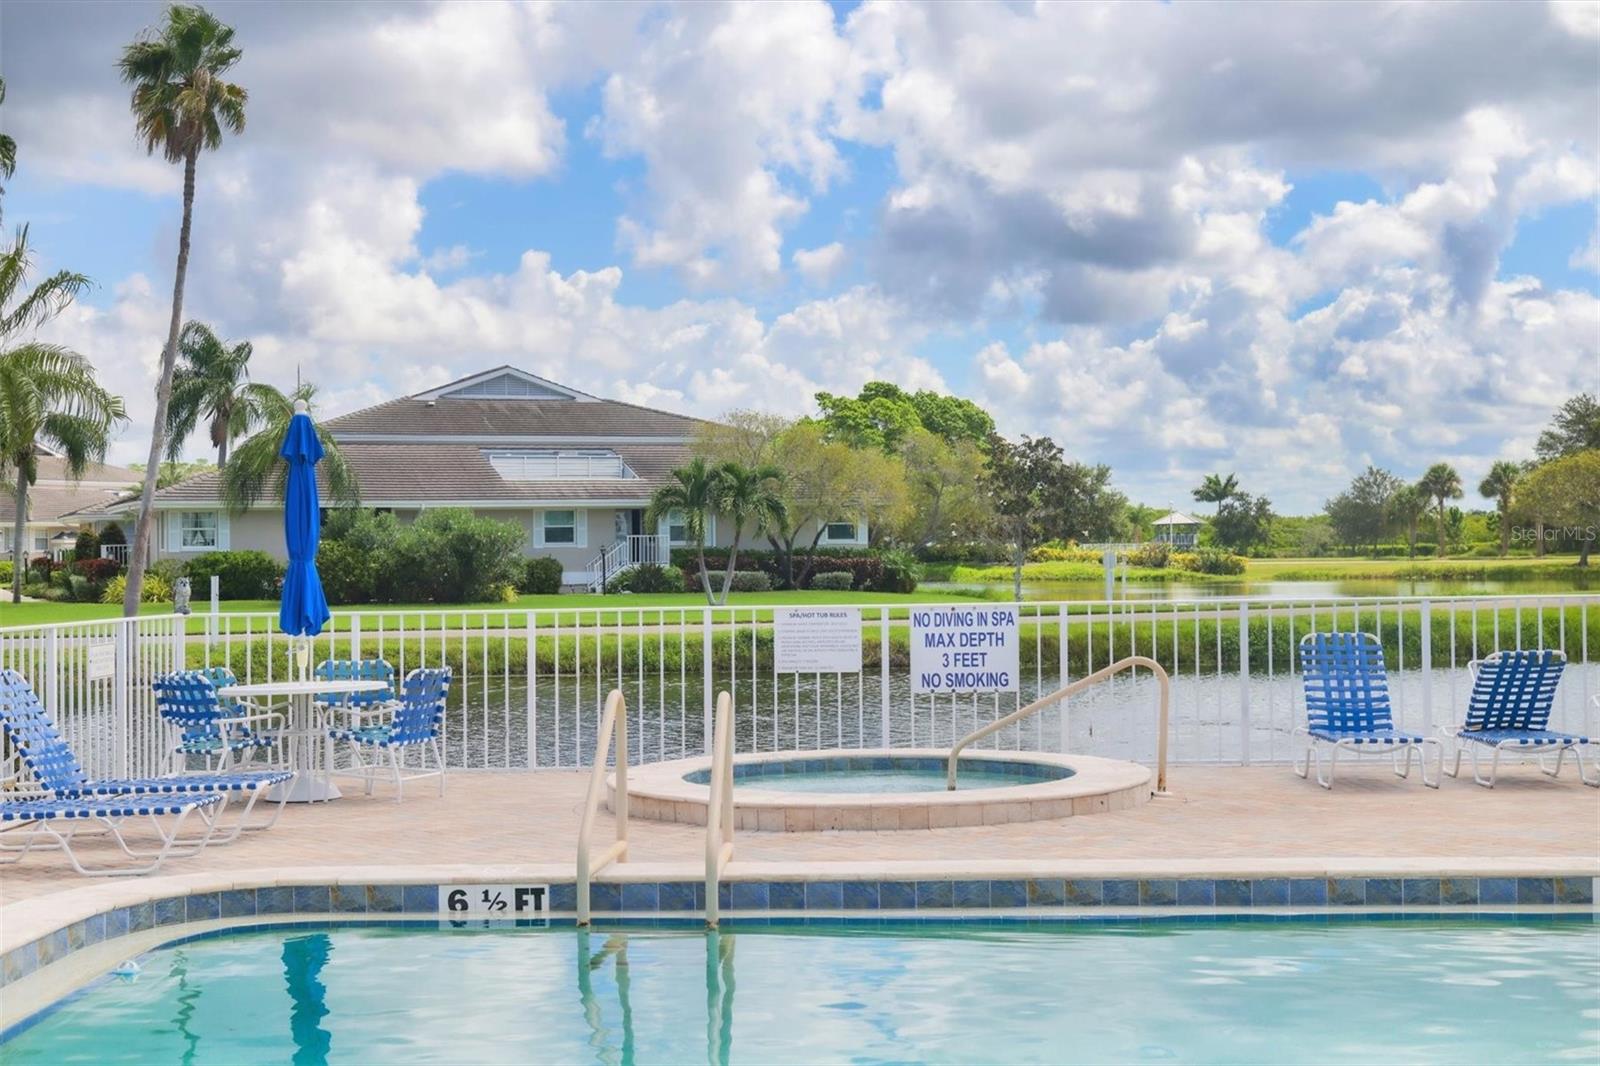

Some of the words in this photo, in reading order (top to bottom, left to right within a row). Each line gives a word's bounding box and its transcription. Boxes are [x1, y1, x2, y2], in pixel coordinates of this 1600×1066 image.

[913, 612, 931, 627] NO
[934, 612, 973, 627] DIVING
[977, 612, 988, 626] IN
[991, 611, 1015, 626] SPA
[925, 633, 956, 648] MAX
[959, 632, 1005, 647] DEPTH
[942, 653, 950, 668] 3
[954, 652, 987, 667] FEET
[922, 673, 941, 688] NO
[945, 672, 1009, 688] SMOKING
[447, 889, 469, 911] 6
[514, 888, 545, 911] FT
